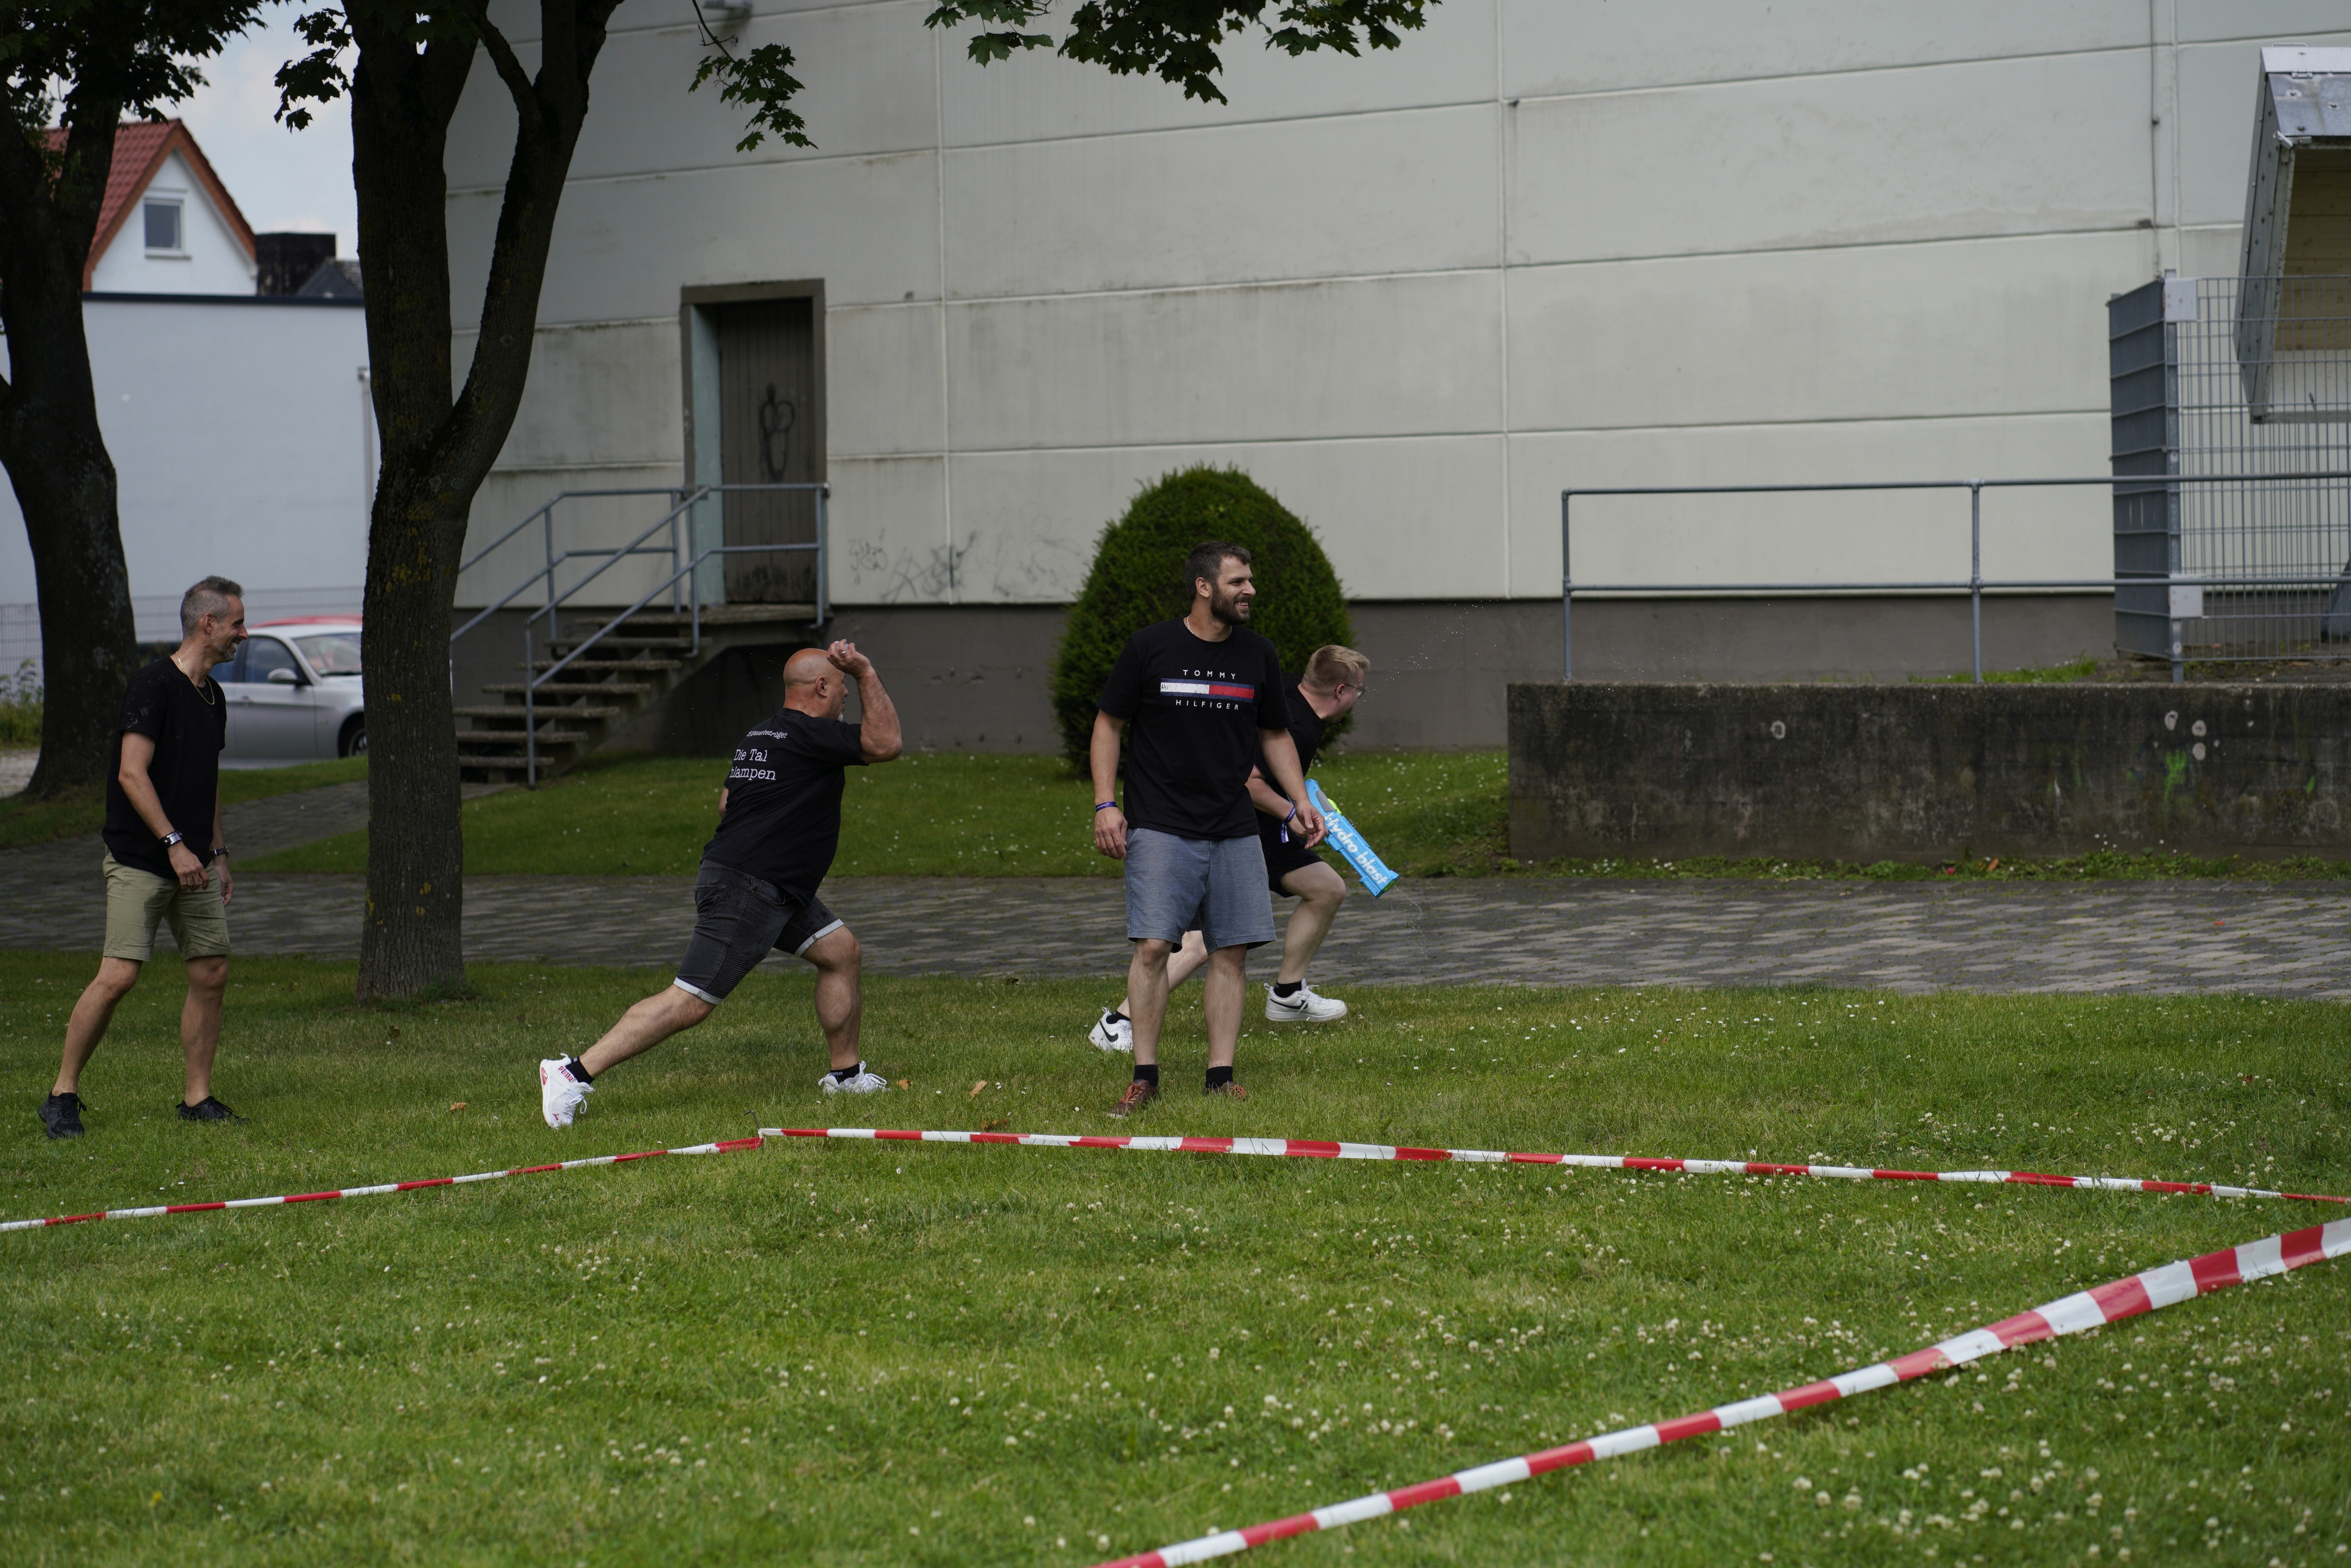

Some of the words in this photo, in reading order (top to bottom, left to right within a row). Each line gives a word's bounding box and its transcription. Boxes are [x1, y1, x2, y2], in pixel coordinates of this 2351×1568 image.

[1183, 669, 1236, 680] TOMMY
[1176, 699, 1239, 710] HILFIGER
[733, 749, 747, 761] Die
[749, 749, 768, 762] Tal
[729, 766, 776, 780] hlampen
[1324, 812, 1358, 853] Hydro
[1355, 851, 1388, 885] blast
[558, 1065, 574, 1081] PUMA
